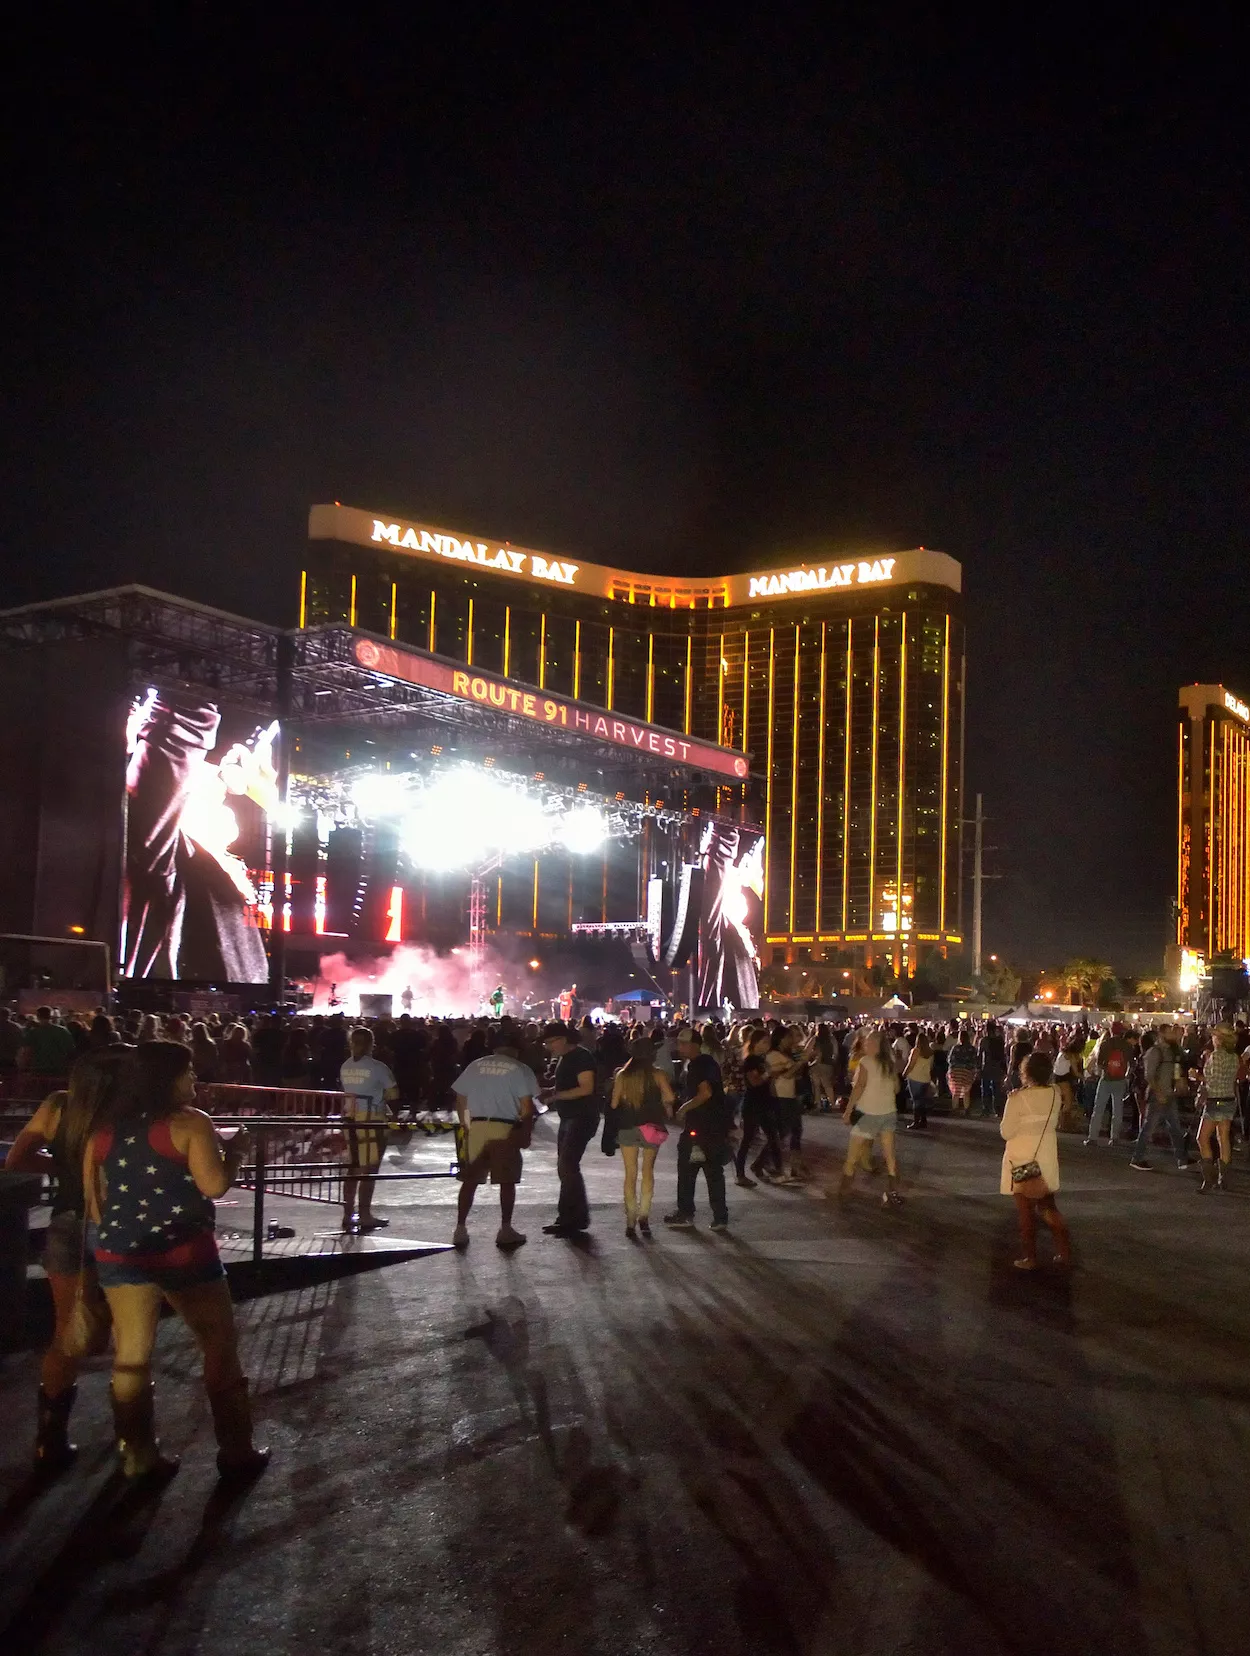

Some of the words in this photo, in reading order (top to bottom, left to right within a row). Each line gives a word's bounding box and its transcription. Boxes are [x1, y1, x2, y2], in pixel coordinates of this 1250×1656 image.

[371, 520, 527, 574] MANDALAY
[531, 555, 579, 585] BAY
[748, 564, 855, 597] MANDALAY
[857, 558, 896, 583] BAY
[453, 670, 537, 717] ROUTE
[543, 700, 567, 725] 91
[575, 709, 691, 760] HARVEST
